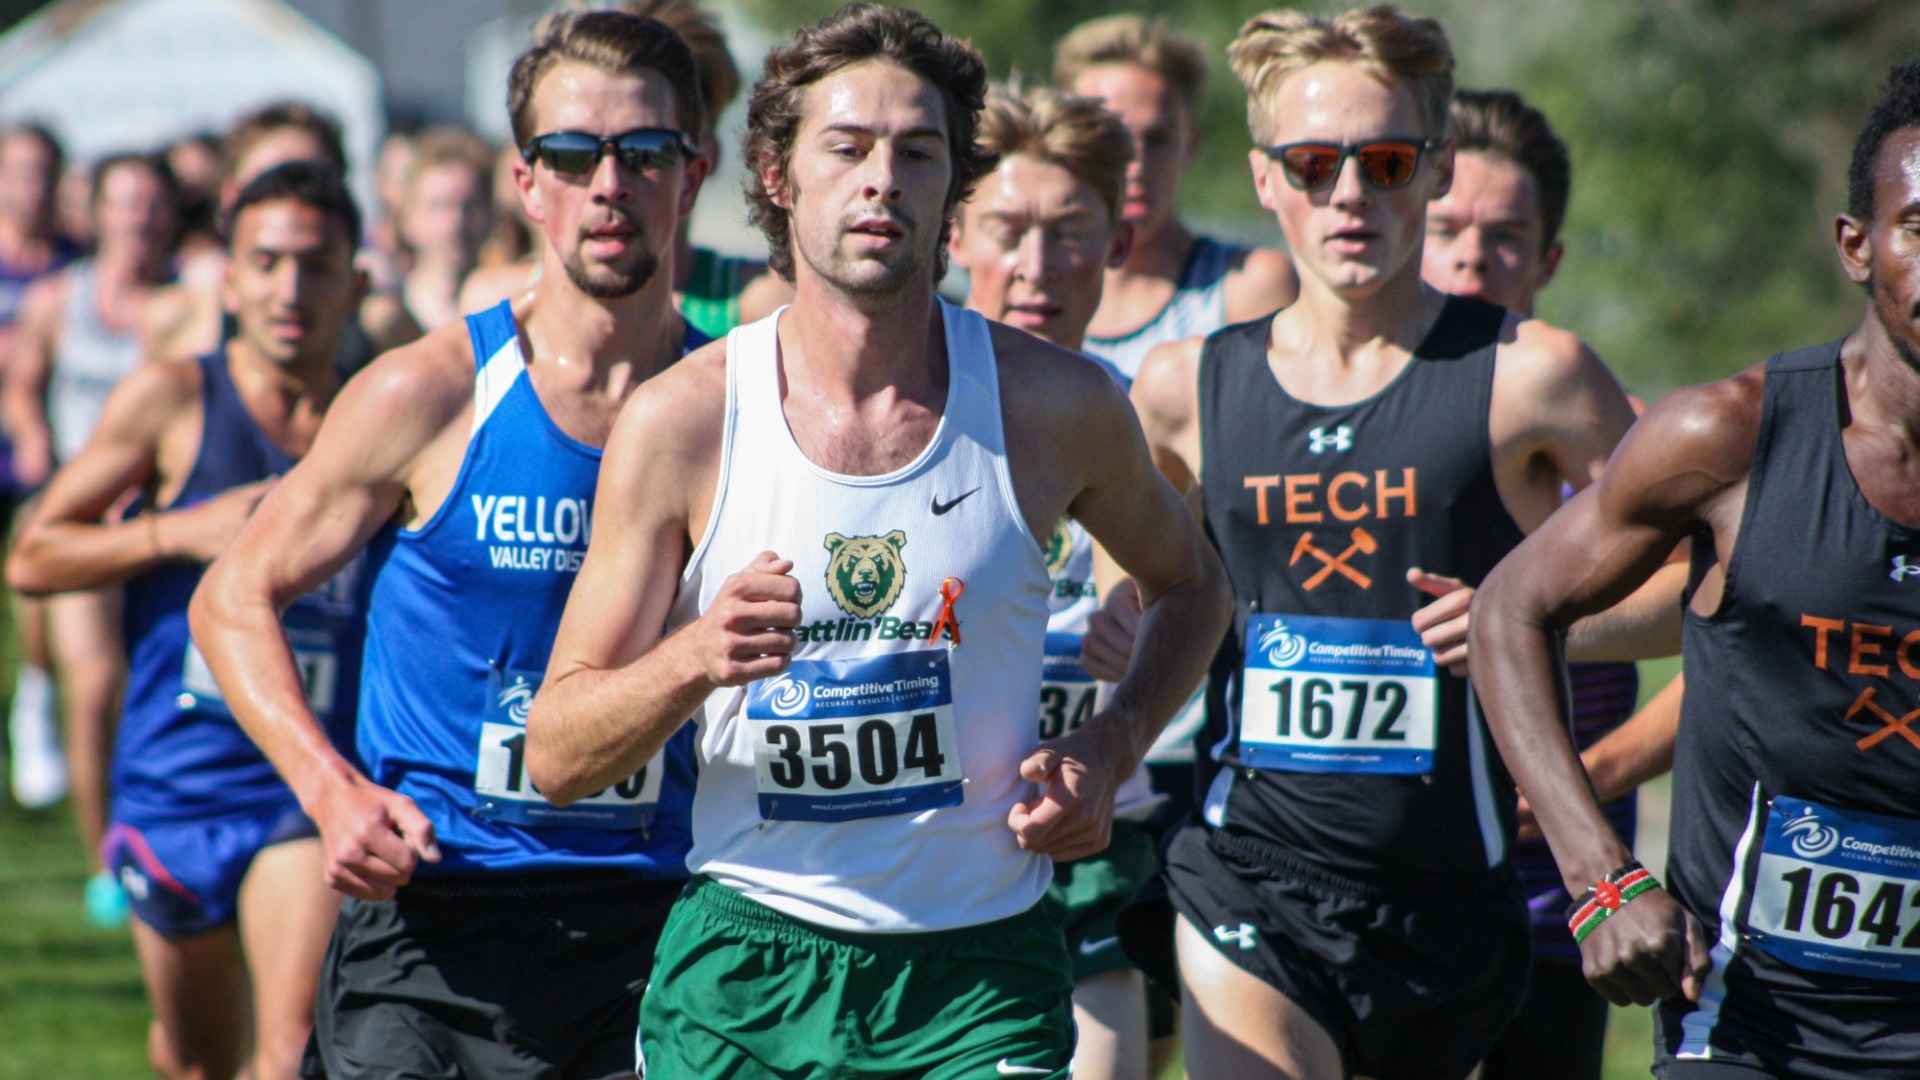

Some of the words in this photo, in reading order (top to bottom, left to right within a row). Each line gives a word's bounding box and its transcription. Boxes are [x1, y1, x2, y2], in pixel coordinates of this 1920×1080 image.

[1244, 467, 1418, 525] TECH
[489, 546, 552, 570] VALLEY
[555, 548, 587, 572] DIS
[857, 696, 890, 705] RESULTS
[1269, 677, 1408, 742] 1672
[501, 732, 647, 799] 10
[765, 712, 945, 790] 3504
[810, 797, 907, 811] www.CompetitiveTiming.com
